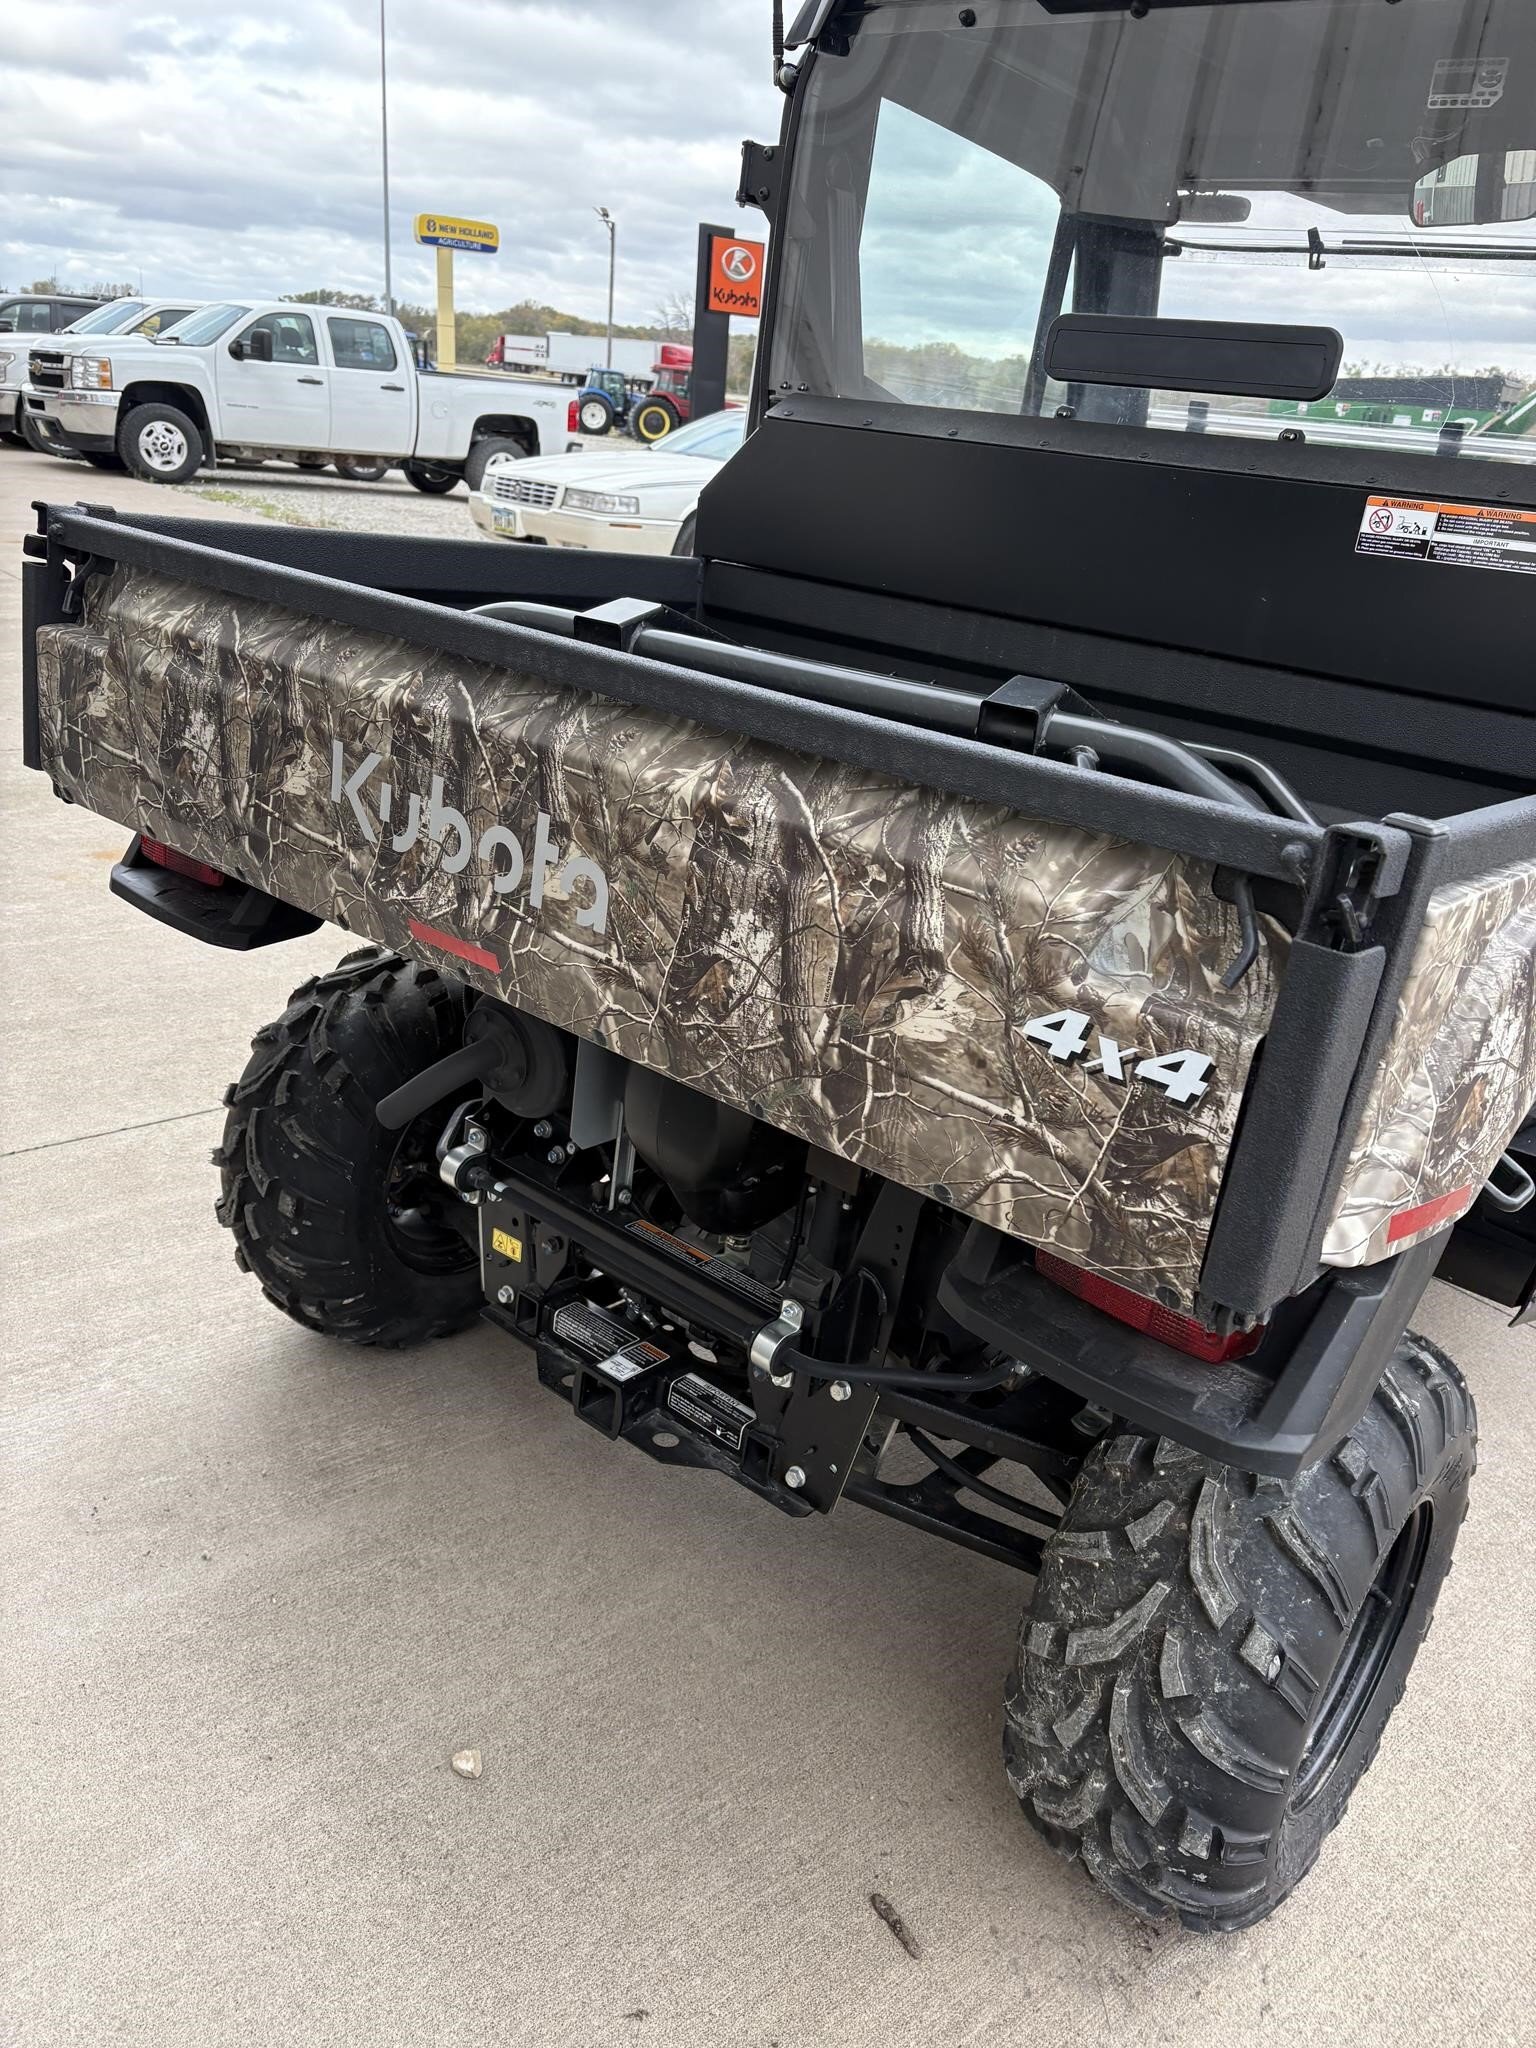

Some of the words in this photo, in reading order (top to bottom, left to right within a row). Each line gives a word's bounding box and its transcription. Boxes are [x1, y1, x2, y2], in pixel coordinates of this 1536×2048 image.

[438, 223, 457, 234] NEW
[459, 226, 495, 240] HOLLAND
[438, 237, 482, 250] AGRICULTURE
[713, 287, 758, 308] Kubota
[1390, 500, 1424, 510] WARNING
[1486, 510, 1522, 520] WARNING
[1472, 538, 1510, 548] IMPORTANT
[331, 740, 609, 935] Kubota
[1022, 1007, 1215, 1107] 4x4
